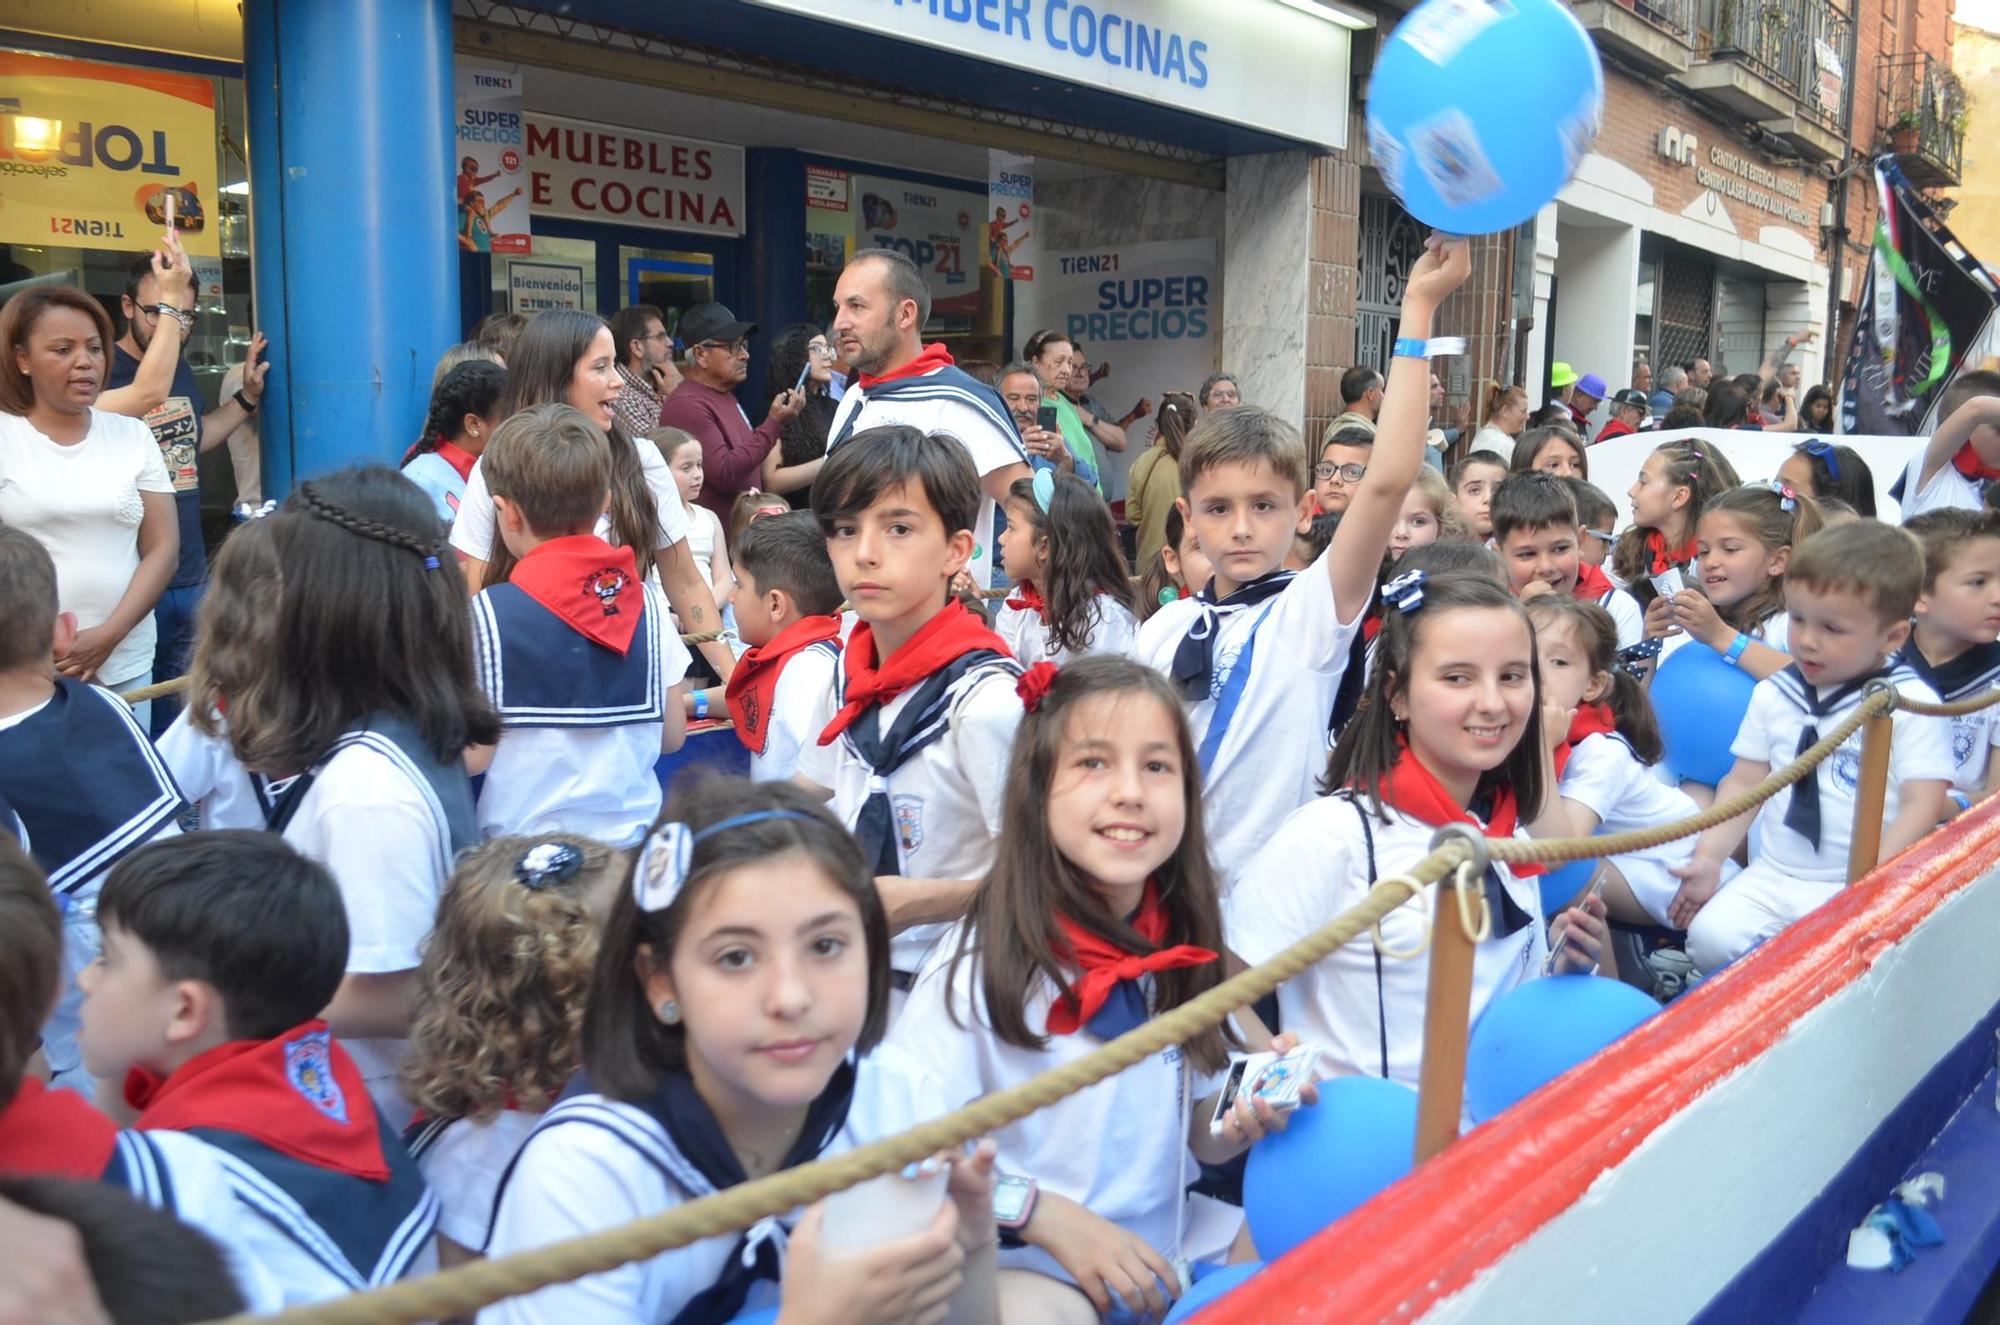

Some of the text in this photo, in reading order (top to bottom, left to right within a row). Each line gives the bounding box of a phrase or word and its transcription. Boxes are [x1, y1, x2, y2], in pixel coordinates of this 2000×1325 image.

[1044, 0, 1208, 89] COCINAS
[464, 109, 520, 128] SUPER
[526, 123, 712, 181] MUEBLES
[1000, 172, 1032, 187] SUPER
[571, 178, 736, 228] COCINA
[513, 276, 580, 292] Bienvenido
[1098, 275, 1209, 311] SUPER
[1067, 307, 1209, 342] PRECIOS
